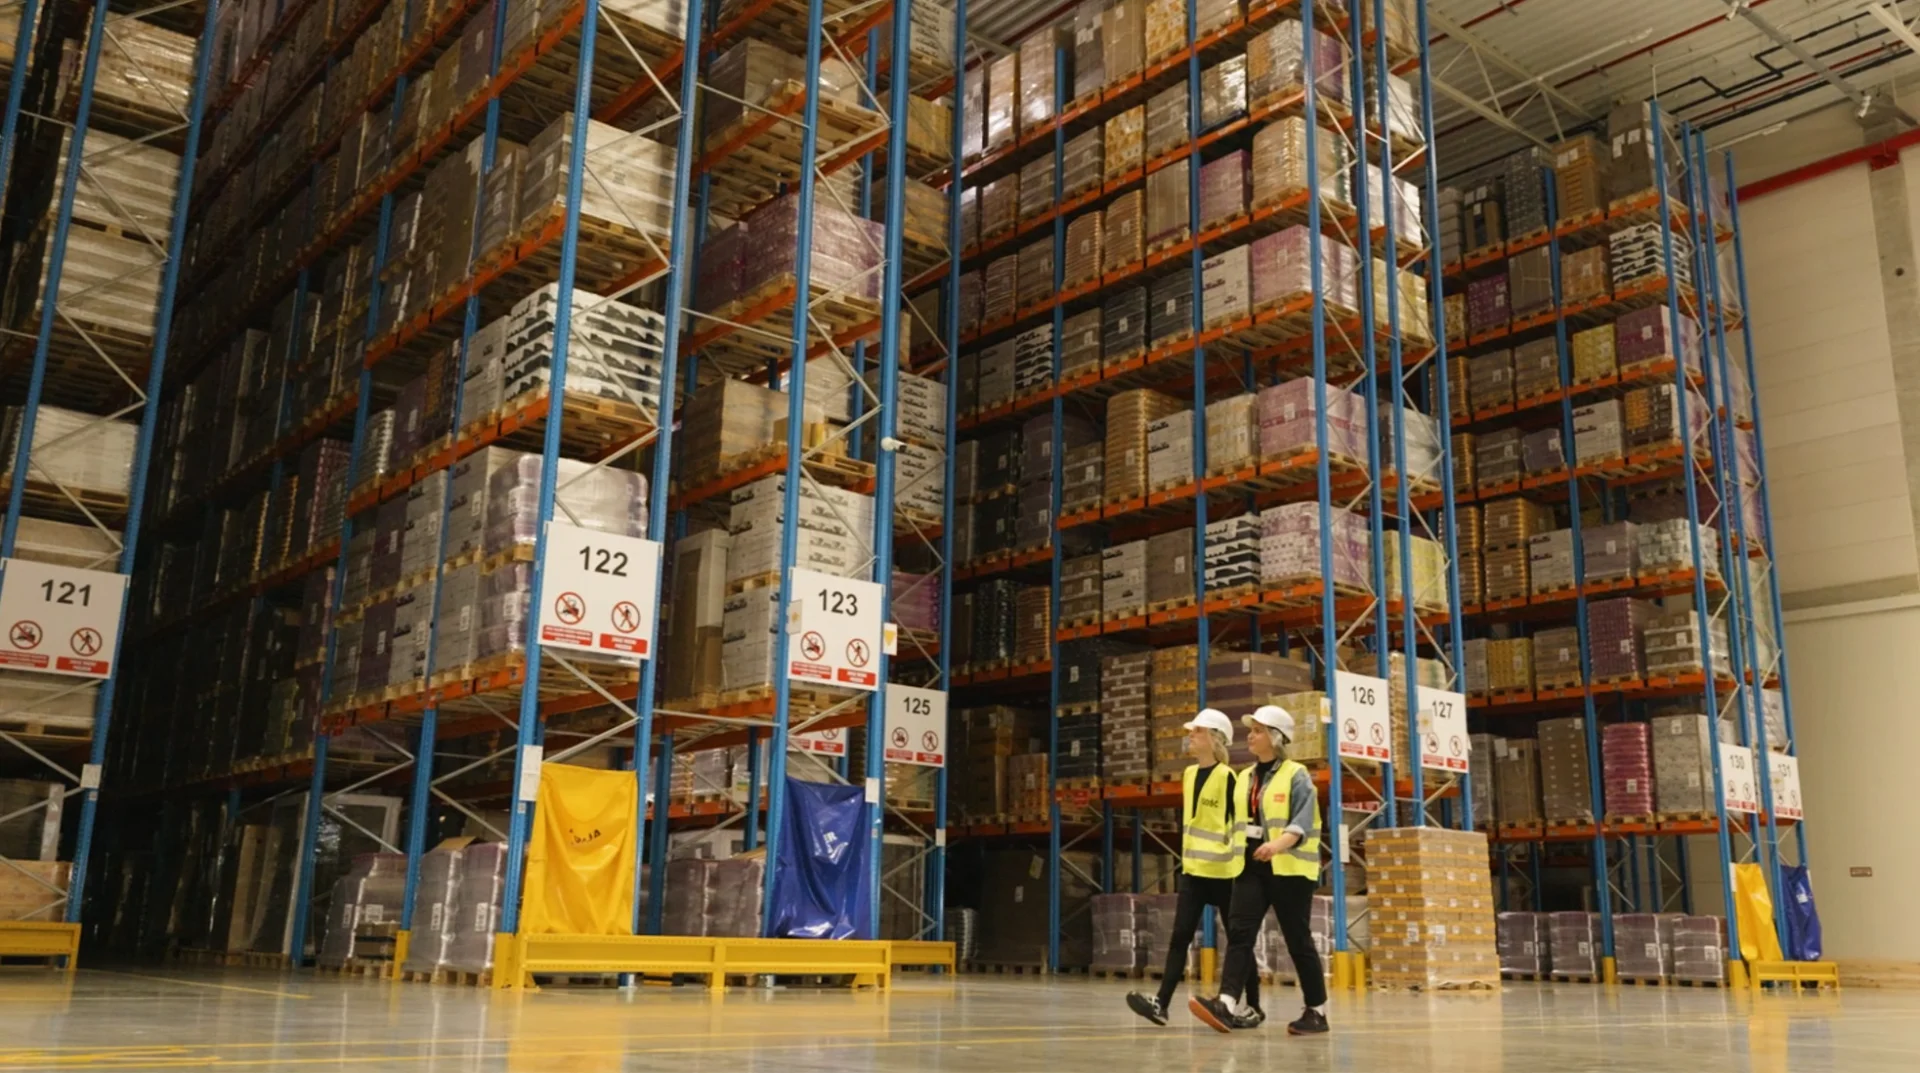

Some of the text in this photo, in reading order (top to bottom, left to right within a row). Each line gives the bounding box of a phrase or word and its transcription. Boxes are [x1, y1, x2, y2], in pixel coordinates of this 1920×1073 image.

[579, 546, 628, 577] 122
[41, 579, 91, 607] 121
[818, 588, 858, 616] 123
[1351, 685, 1375, 706] 126
[903, 697, 931, 716] 125
[1432, 700, 1453, 719] 127
[1729, 755, 1745, 770] 130
